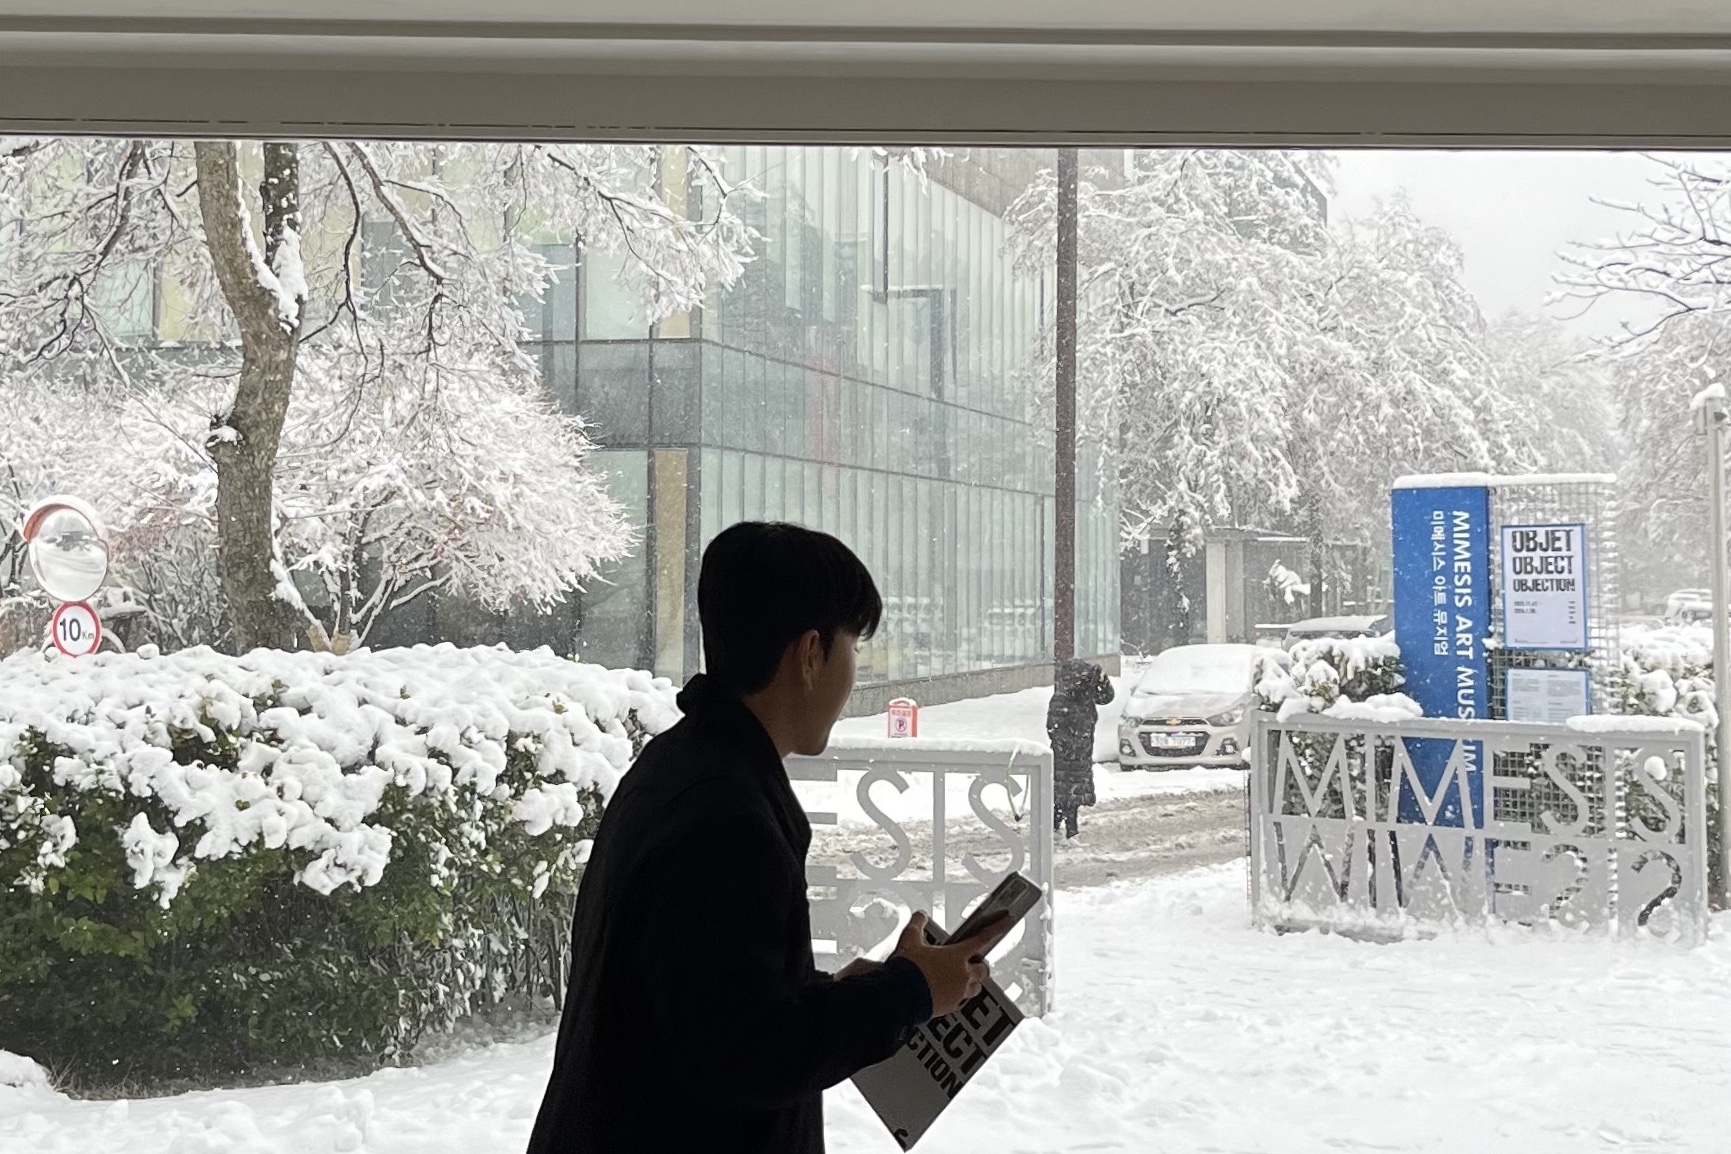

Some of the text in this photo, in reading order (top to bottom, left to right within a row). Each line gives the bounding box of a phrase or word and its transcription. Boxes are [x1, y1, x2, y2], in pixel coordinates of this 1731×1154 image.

[1430, 510, 1449, 656] 미메시스 아트 뮤지엄
[1511, 529, 1574, 553] OBJET
[1512, 555, 1574, 575] OBJECT
[1513, 578, 1576, 592] OBJECTION
[1452, 510, 1477, 772] MIMESIS ART MUSM
[788, 764, 1026, 886] ESIS
[1273, 730, 1682, 842] MIMESIS
